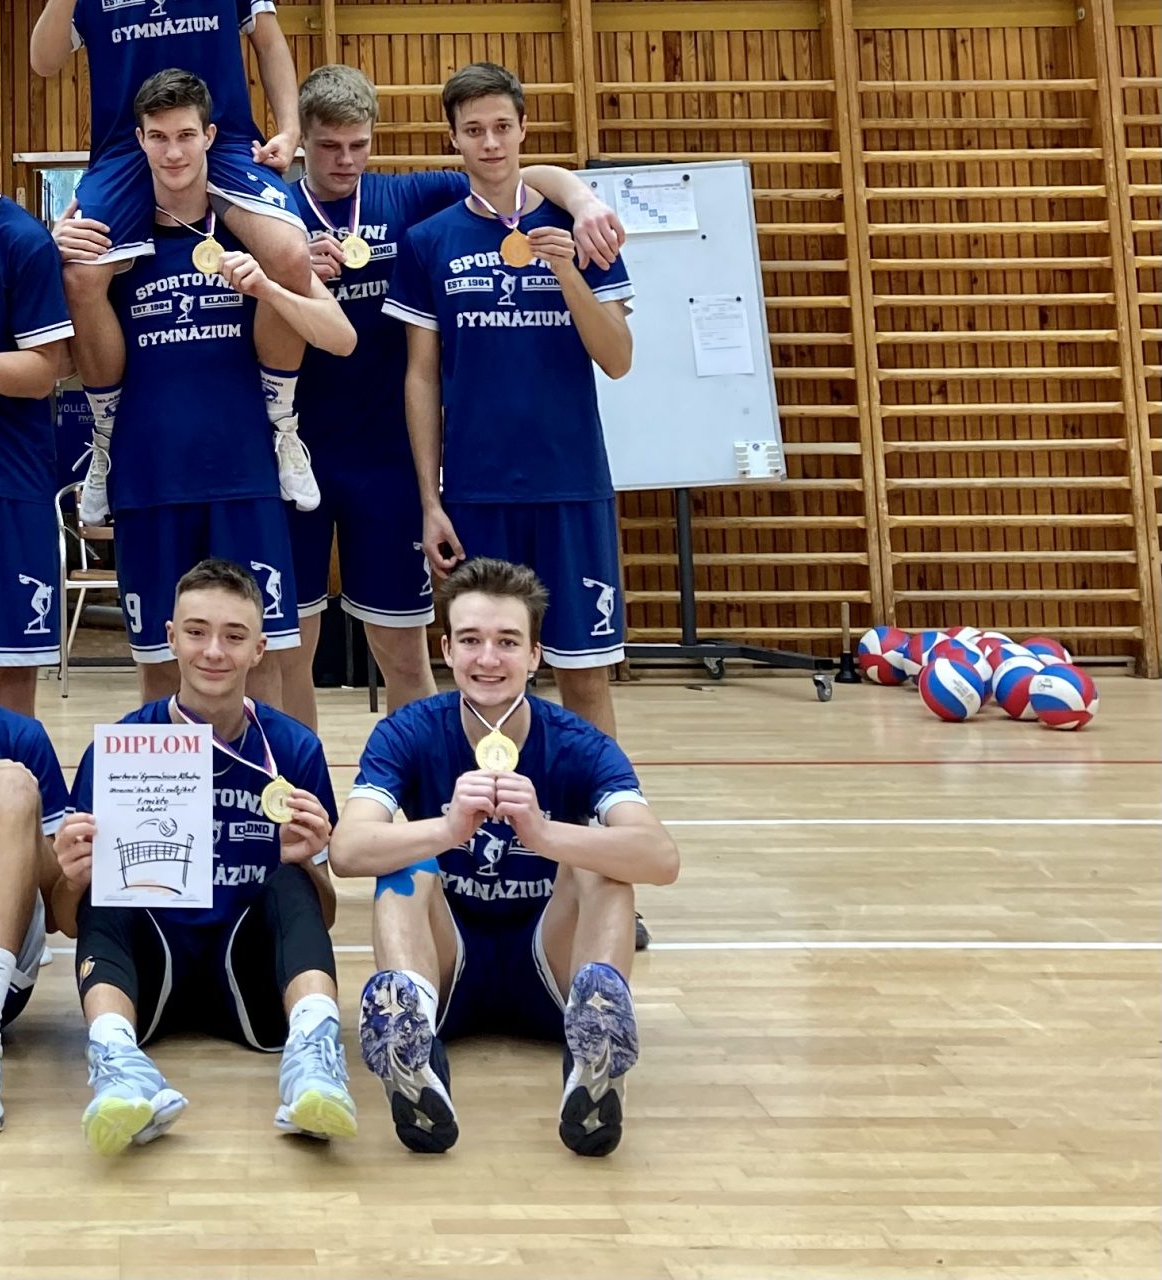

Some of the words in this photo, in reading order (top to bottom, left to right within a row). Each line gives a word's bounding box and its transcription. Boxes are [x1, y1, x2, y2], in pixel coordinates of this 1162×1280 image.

[111, 15, 220, 43] GYMNÁZIUM
[135, 272, 236, 301] SPORTOVN
[527, 277, 560, 286] KLADN
[204, 295, 240, 305] KLADNO
[457, 309, 571, 328] GYMNÁZIUM
[138, 323, 242, 347] GYMNÁZIUM
[104, 735, 202, 754] DIPLOM
